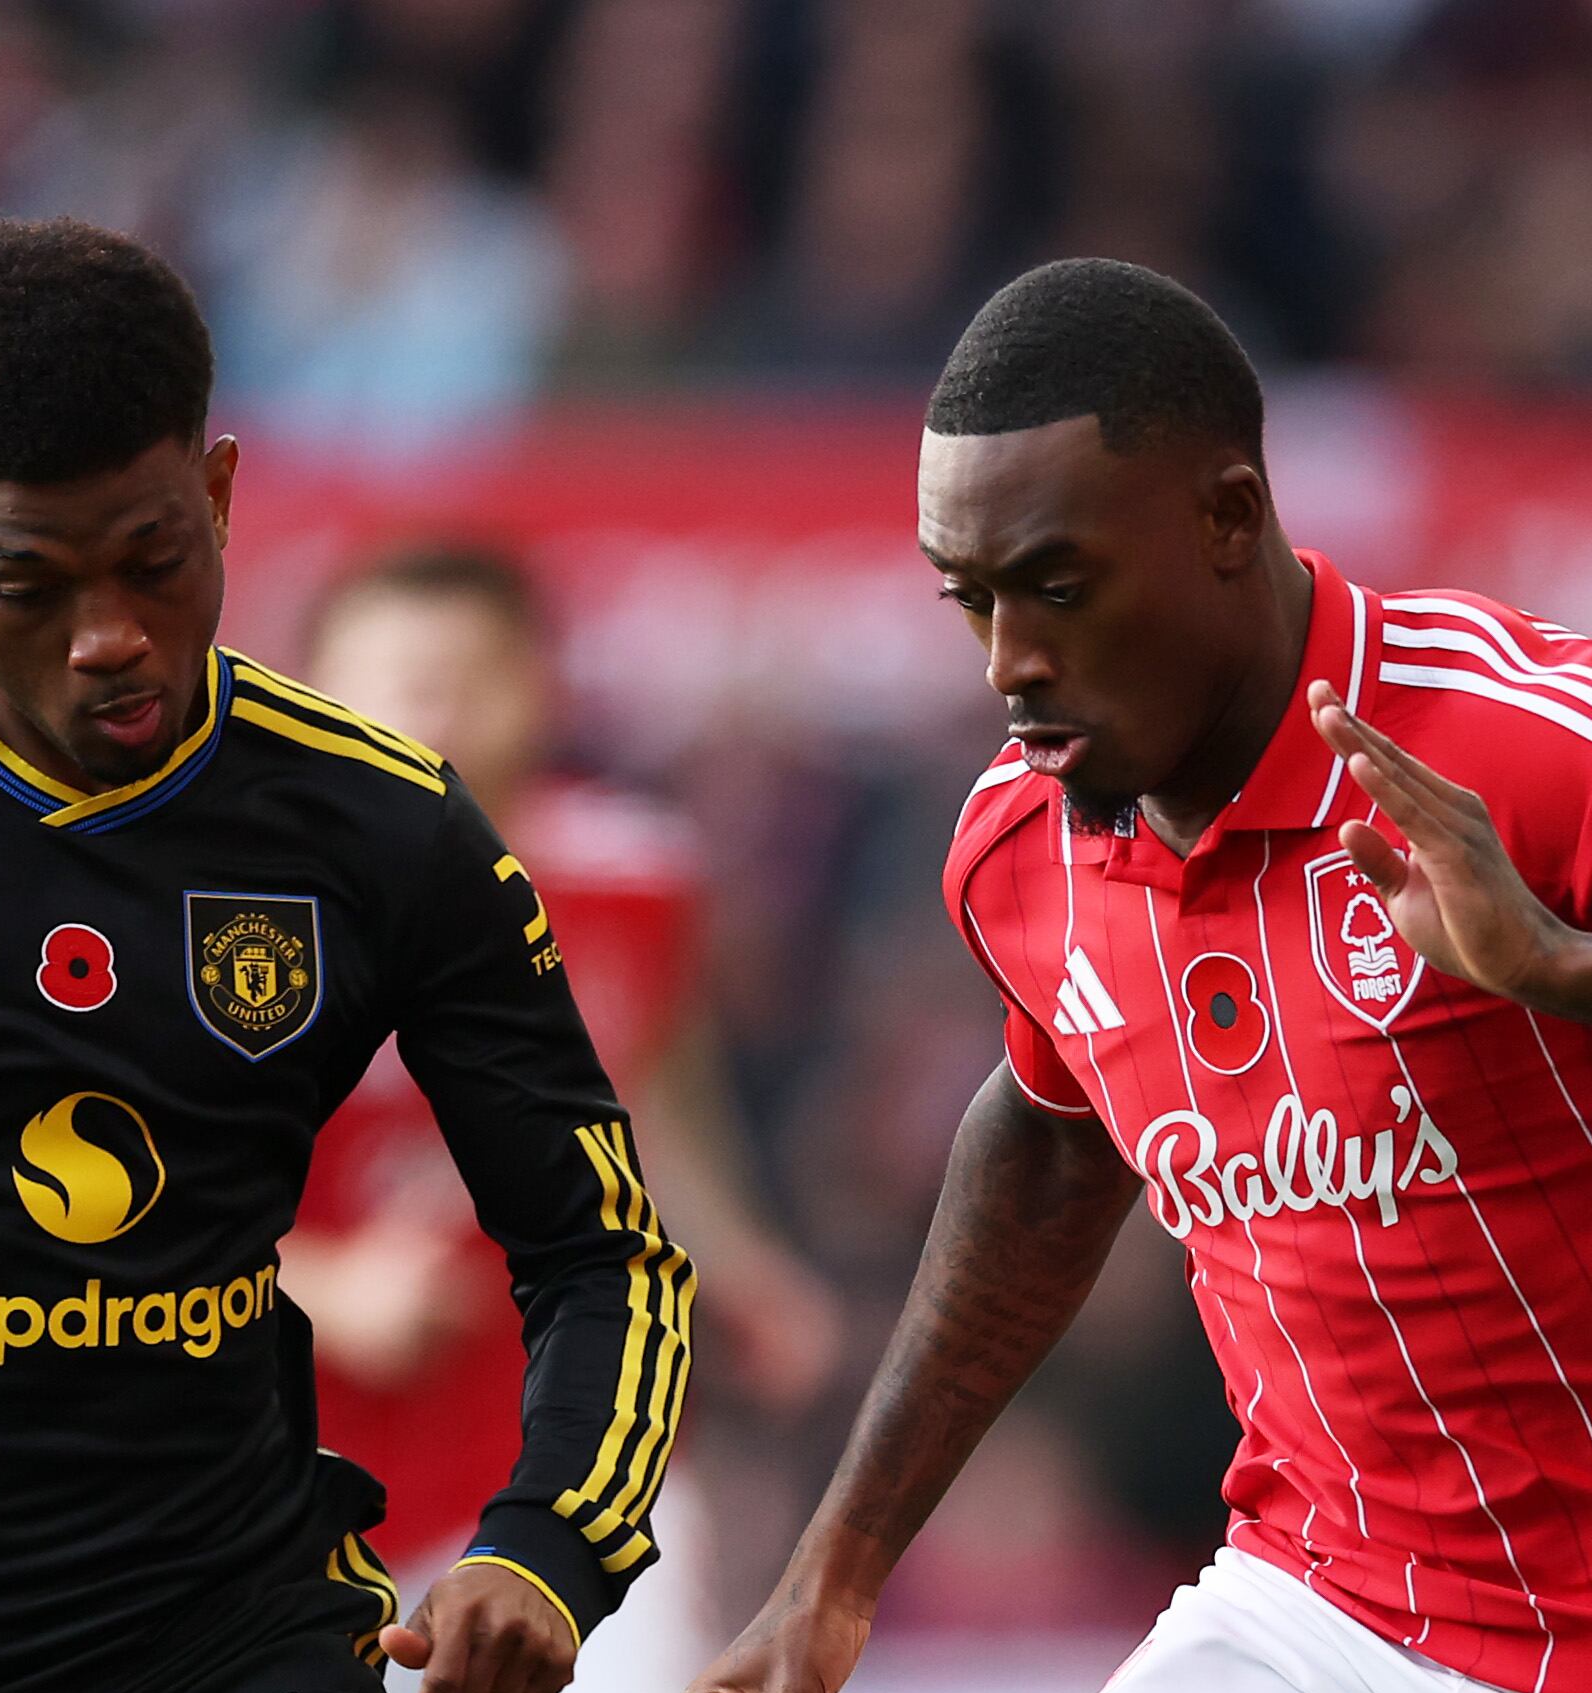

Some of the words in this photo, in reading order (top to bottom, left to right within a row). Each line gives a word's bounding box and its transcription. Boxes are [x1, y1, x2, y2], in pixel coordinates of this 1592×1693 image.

[211, 922, 297, 960] MANCHESTER
[227, 1002, 286, 1022] UNITED
[1136, 1085, 1457, 1239] Bally's
